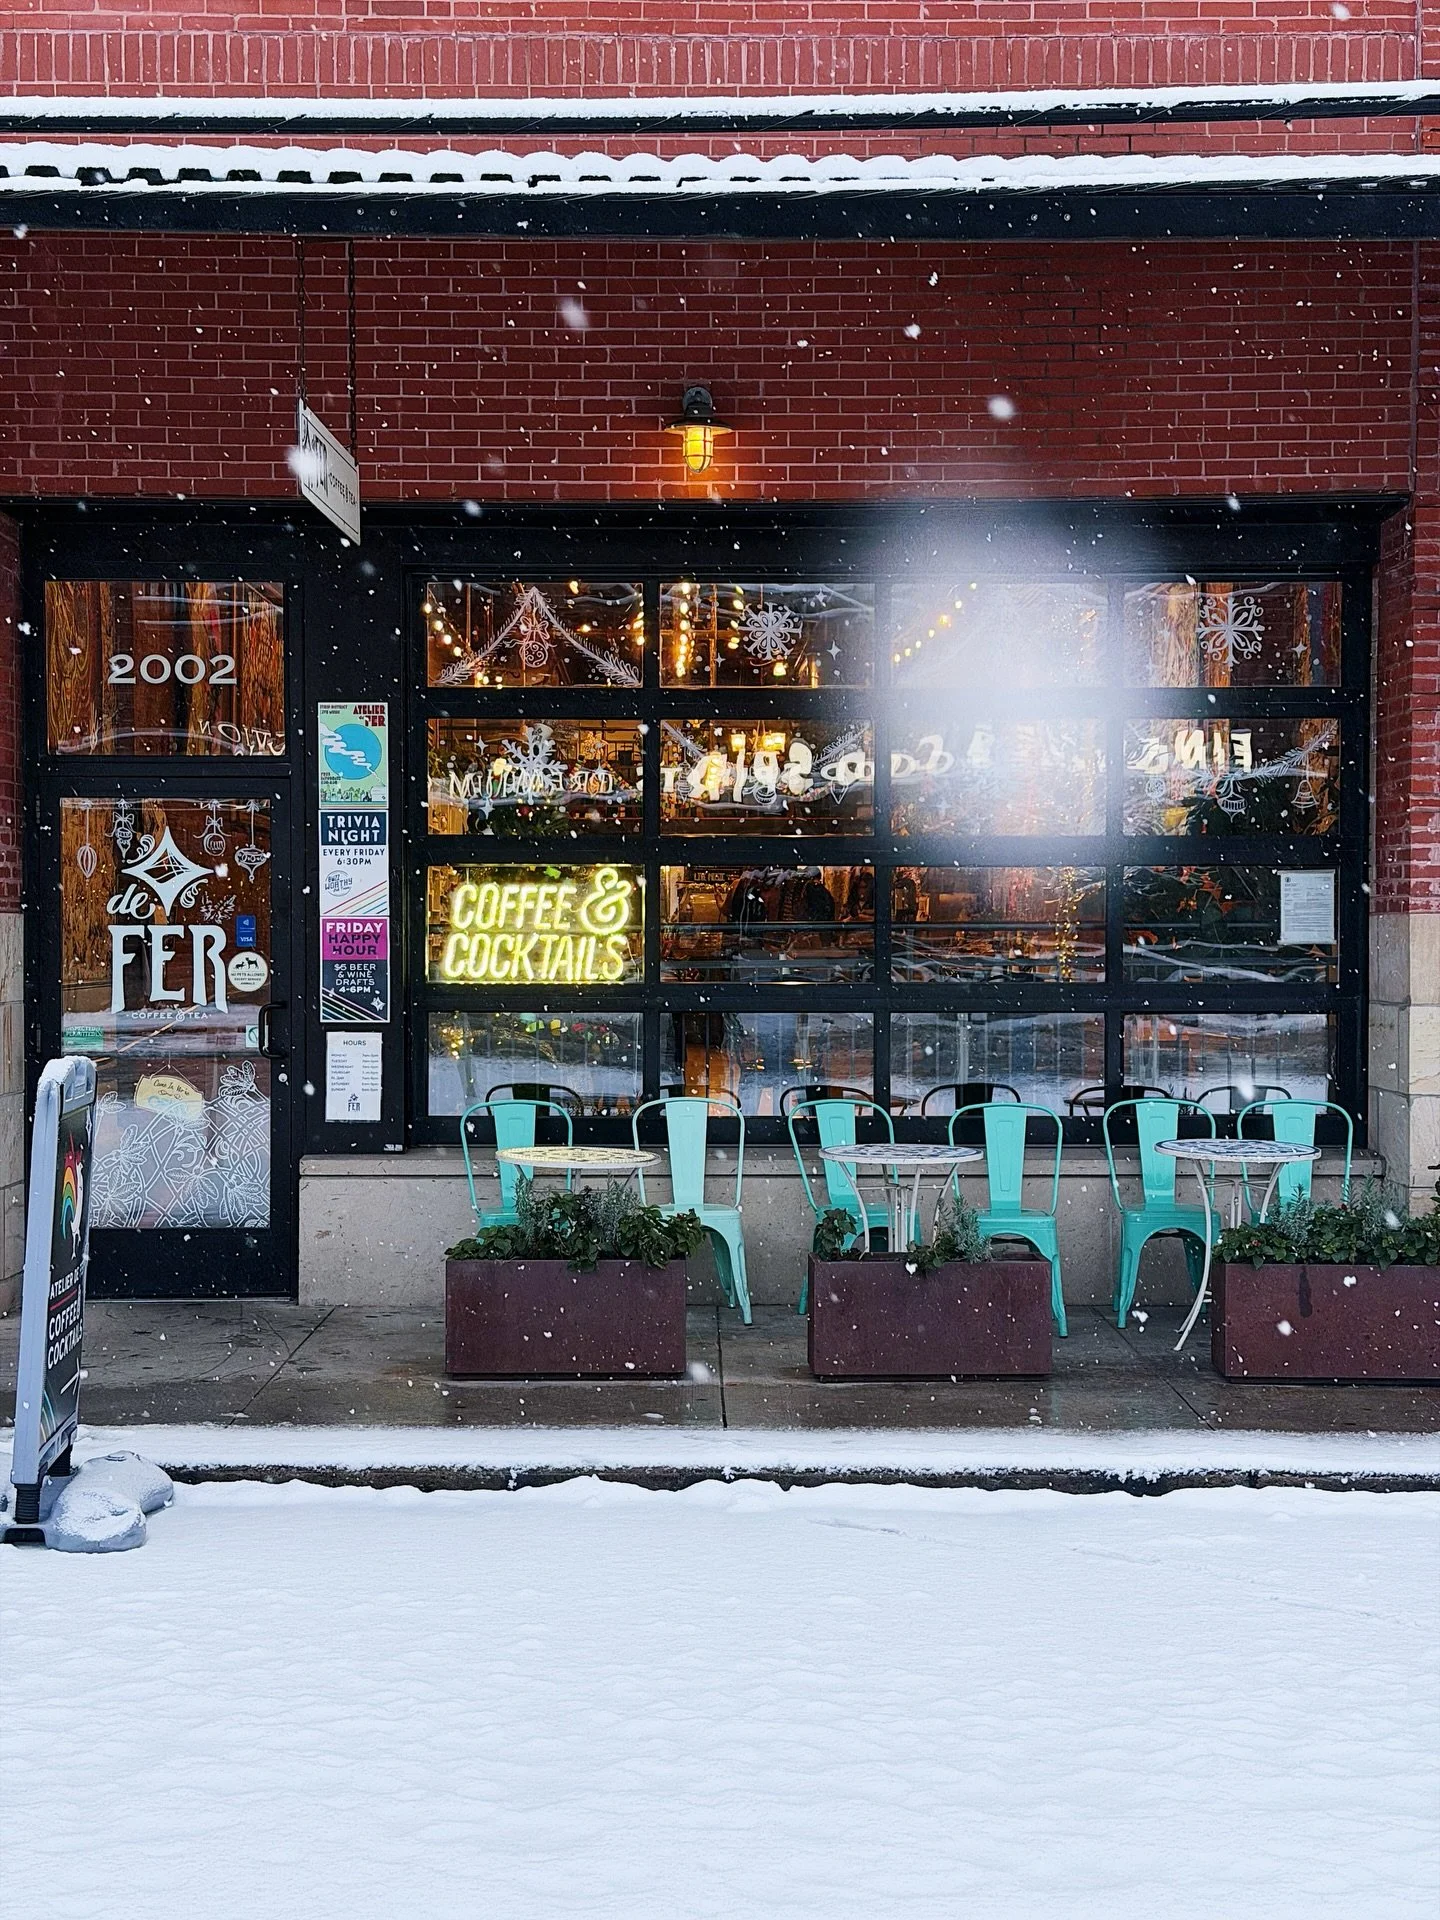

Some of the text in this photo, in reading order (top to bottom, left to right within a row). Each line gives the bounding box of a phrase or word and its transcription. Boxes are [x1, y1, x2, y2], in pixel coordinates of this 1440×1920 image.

[107, 654, 238, 685] 2002
[352, 704, 386, 715] ATELIER
[327, 815, 381, 828] TRIVIA
[328, 829, 380, 842] NIGHT
[322, 848, 385, 857] EVERY FRIDAY
[336, 857, 372, 866] 6:30PM
[106, 883, 156, 920] de
[451, 867, 632, 936] COFFEE &
[326, 922, 384, 933] FRIDAY
[328, 934, 381, 944] HAPPY
[332, 945, 377, 955] HOUR
[443, 932, 628, 981] COCKTAILS
[107, 924, 229, 1014] FER
[333, 963, 377, 971] $5 BEER
[337, 971, 345, 979] &
[335, 978, 375, 986] DRAFTS
[131, 1009, 209, 1022] COFFEE & TEA
[50, 1272, 74, 1300] ATELIER
[48, 1300, 78, 1341] COFFEE
[47, 1318, 83, 1370] COCKTAILS
